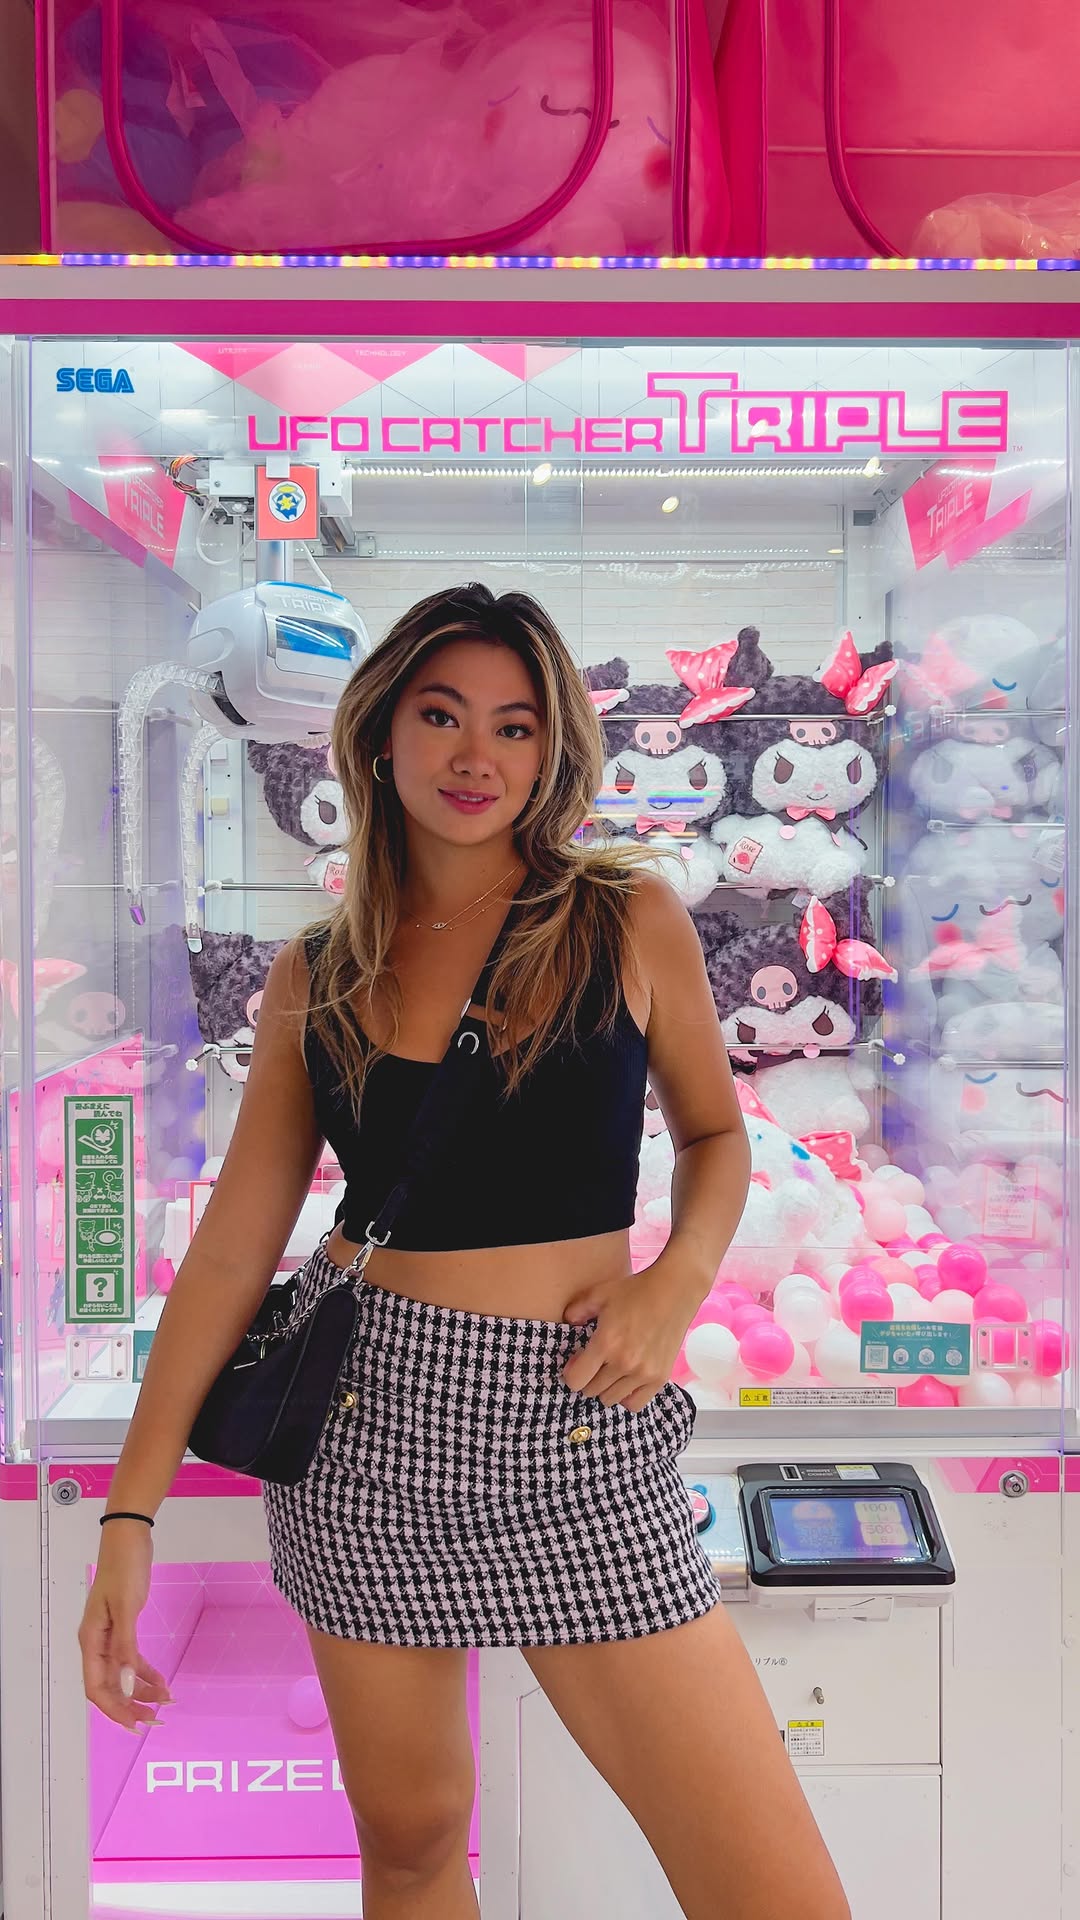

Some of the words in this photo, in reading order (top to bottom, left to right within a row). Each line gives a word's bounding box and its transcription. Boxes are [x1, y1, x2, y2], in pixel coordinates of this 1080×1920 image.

[355, 349, 406, 357] TECHNOLOGY
[56, 367, 135, 393] SEGA
[247, 414, 370, 452] UFO
[381, 417, 663, 453] CATCHER
[647, 372, 1008, 453] TRIPLE
[121, 475, 166, 540] TRIPLE
[926, 481, 974, 539] TRIPLE
[273, 593, 345, 619] TRIPLE
